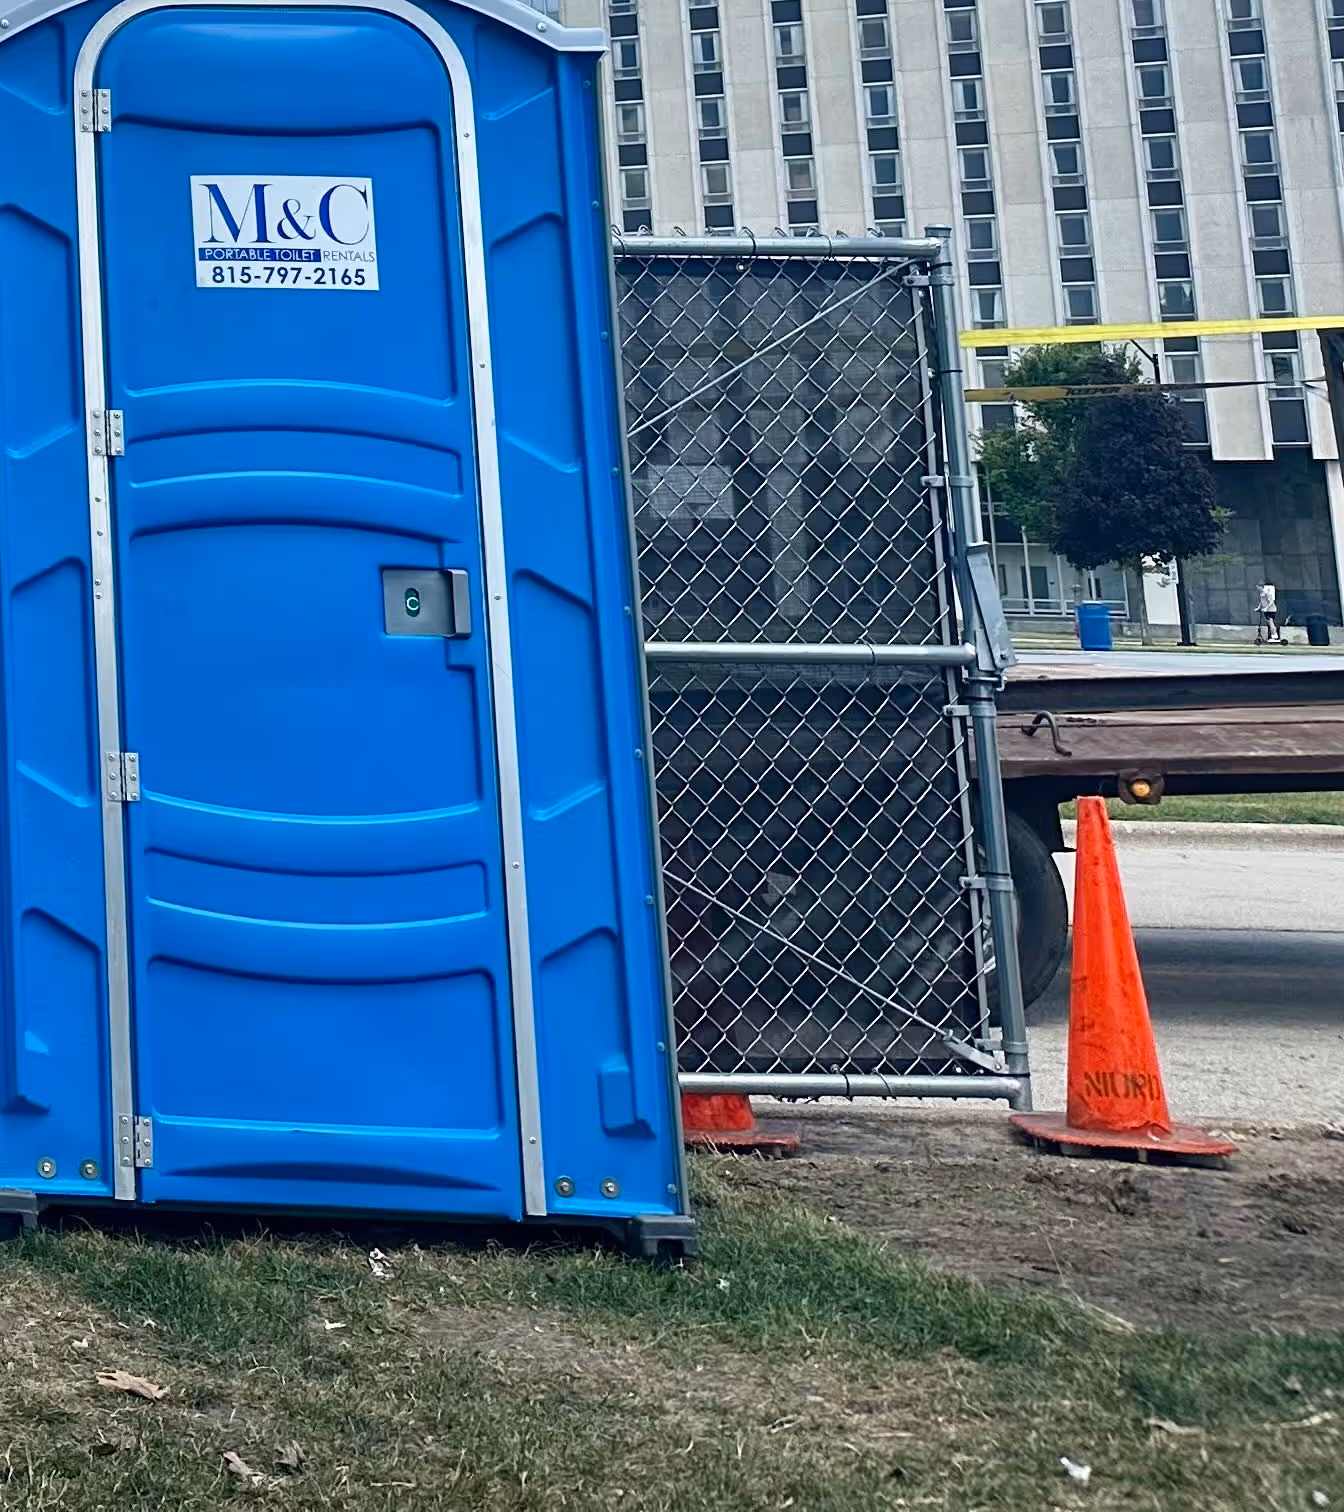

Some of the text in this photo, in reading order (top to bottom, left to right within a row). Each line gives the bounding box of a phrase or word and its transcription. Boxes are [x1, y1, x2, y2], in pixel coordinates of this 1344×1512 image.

[199, 183, 370, 246] M&C
[204, 249, 375, 263] PORTABLE TOILET RENTALS
[212, 266, 366, 286] 815-797-2165
